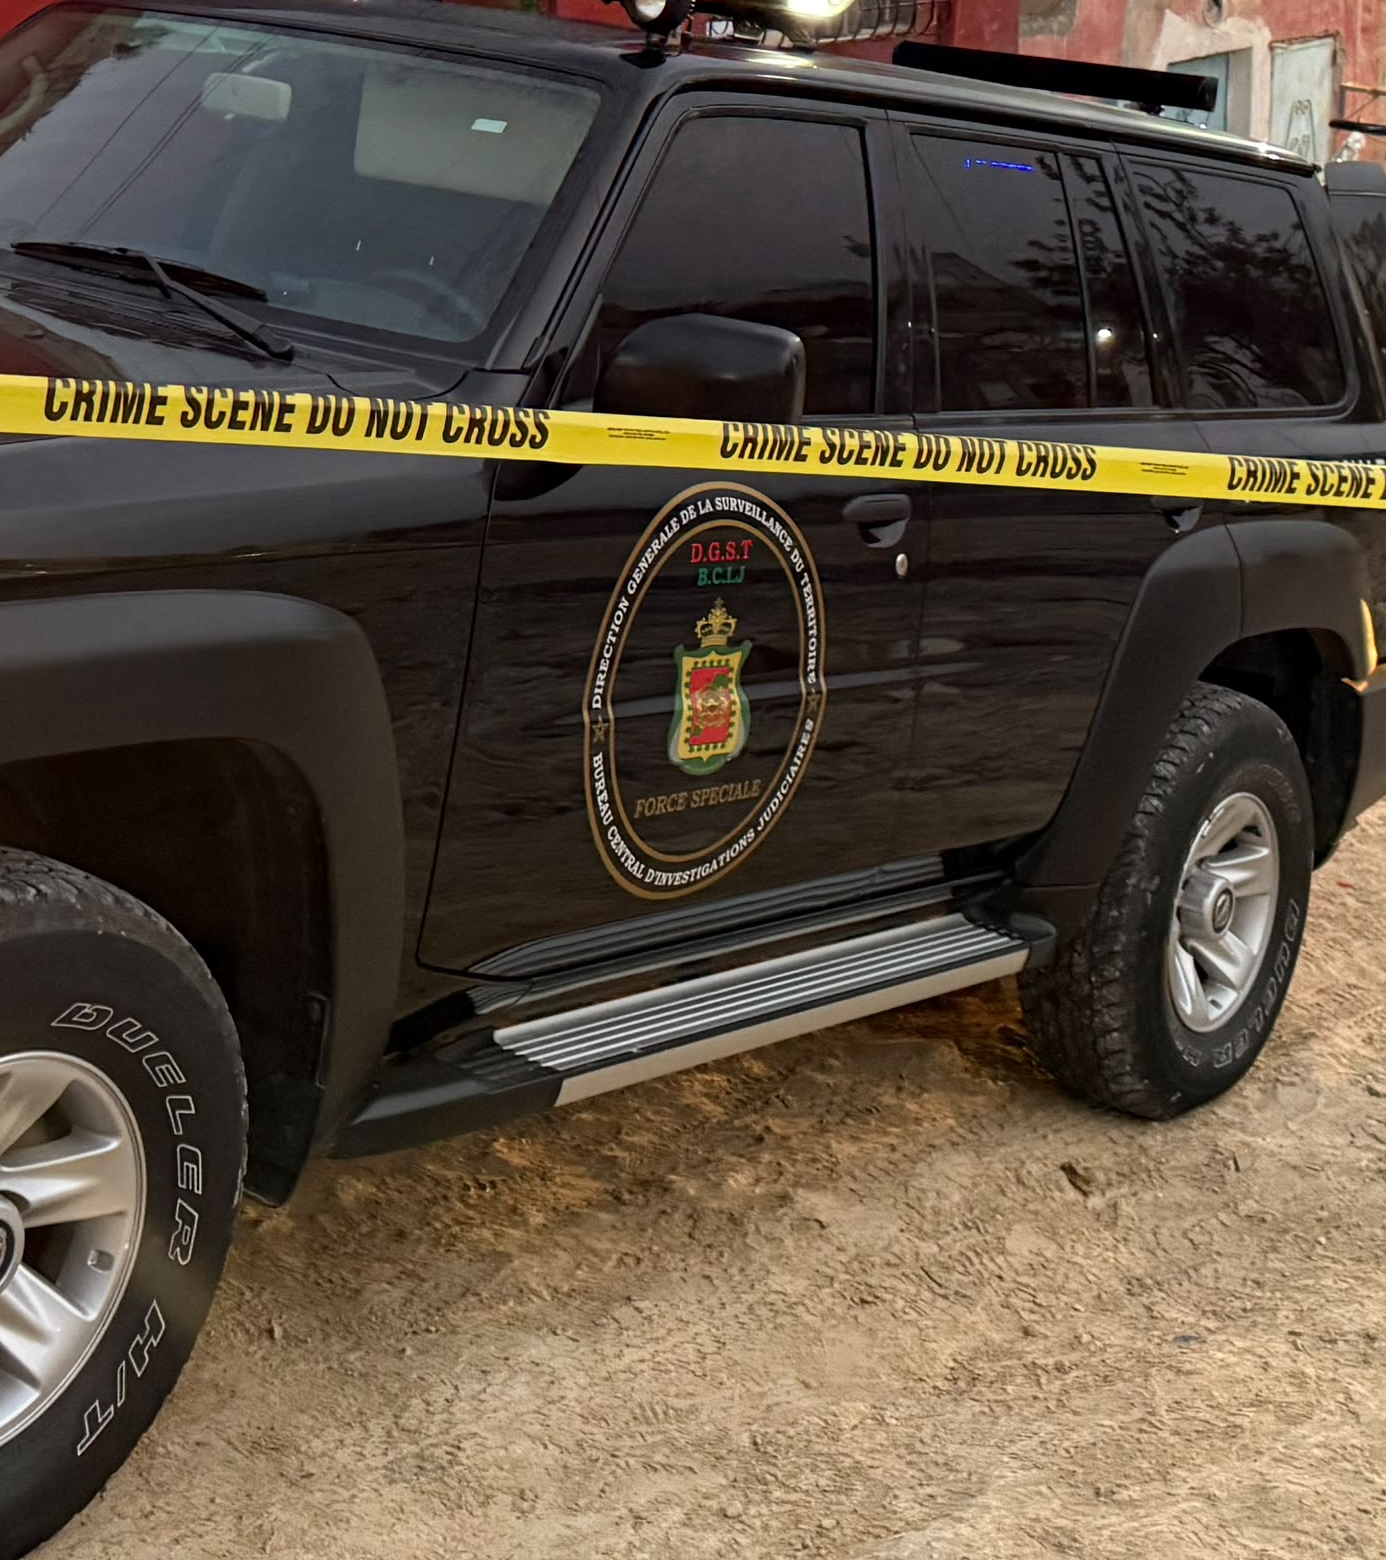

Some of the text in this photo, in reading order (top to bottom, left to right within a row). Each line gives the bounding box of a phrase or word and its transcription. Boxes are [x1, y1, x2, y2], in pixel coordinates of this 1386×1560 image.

[43, 377, 549, 449] CRIME SCENE DO NOT CROSS
[719, 421, 1097, 481] CRIME SCENE DO NOT CROSS
[1227, 456, 1300, 495] CRIME
[1306, 461, 1376, 500] SCENE
[690, 540, 753, 563] D.G.S.T
[592, 497, 817, 708] DIRECTION GENERALE DE LA SURVEILLANCE DU TERRITOIRE
[593, 718, 815, 886] BUREAU CENTRAL D'INVESTIGATIONS JUDICIAIRES
[634, 779, 762, 818] FORCE SPECIALE
[50, 1001, 204, 1266] DUELER
